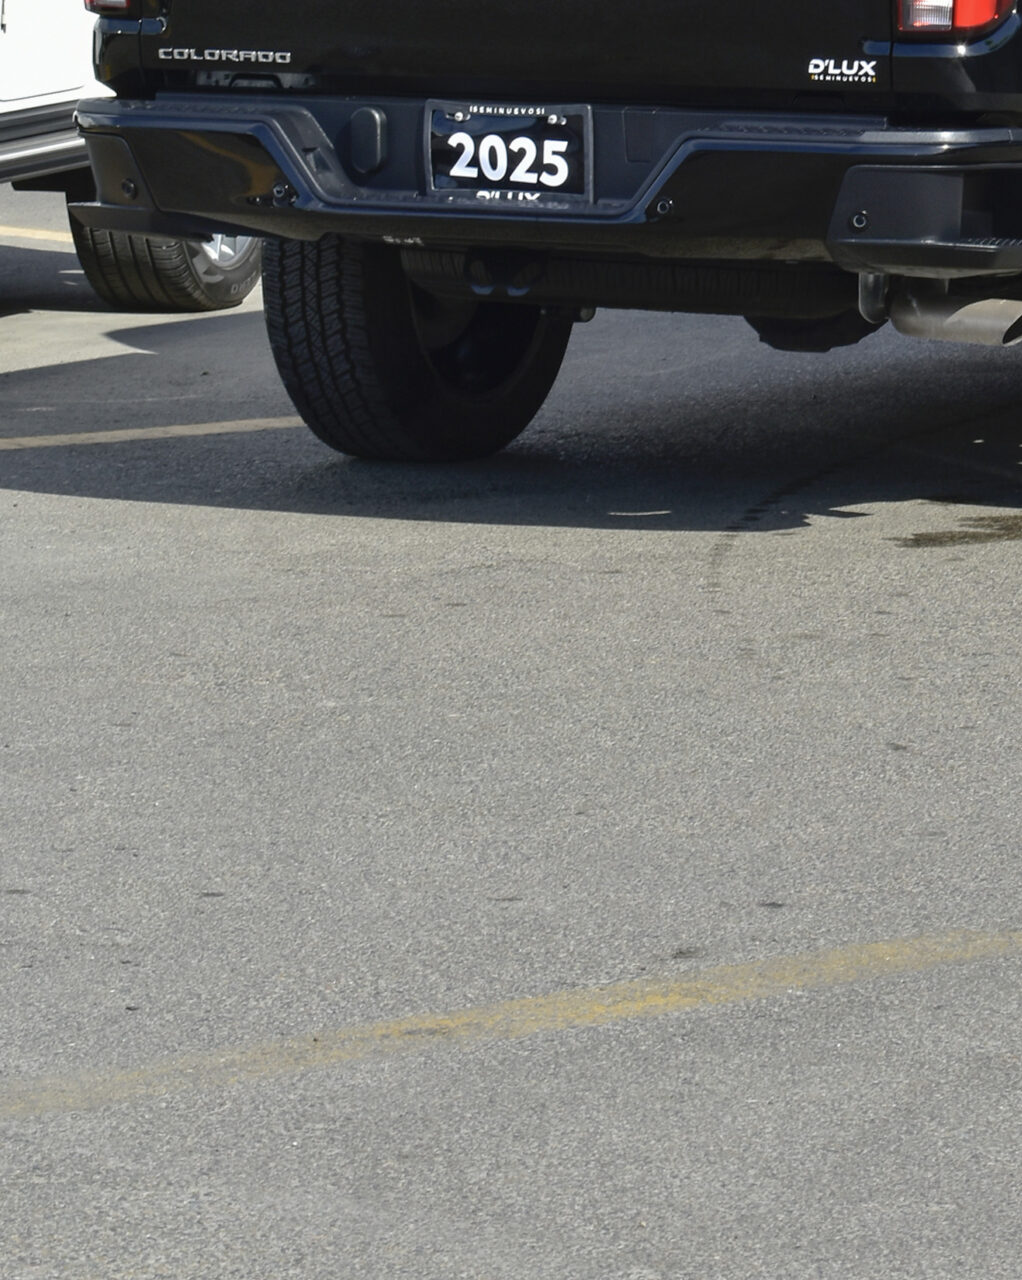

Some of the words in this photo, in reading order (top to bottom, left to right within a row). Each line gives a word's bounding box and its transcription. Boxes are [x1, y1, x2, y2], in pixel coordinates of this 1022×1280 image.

[158, 47, 291, 63] COLORADO
[808, 58, 877, 76] D'LUX
[447, 131, 569, 187] 2025
